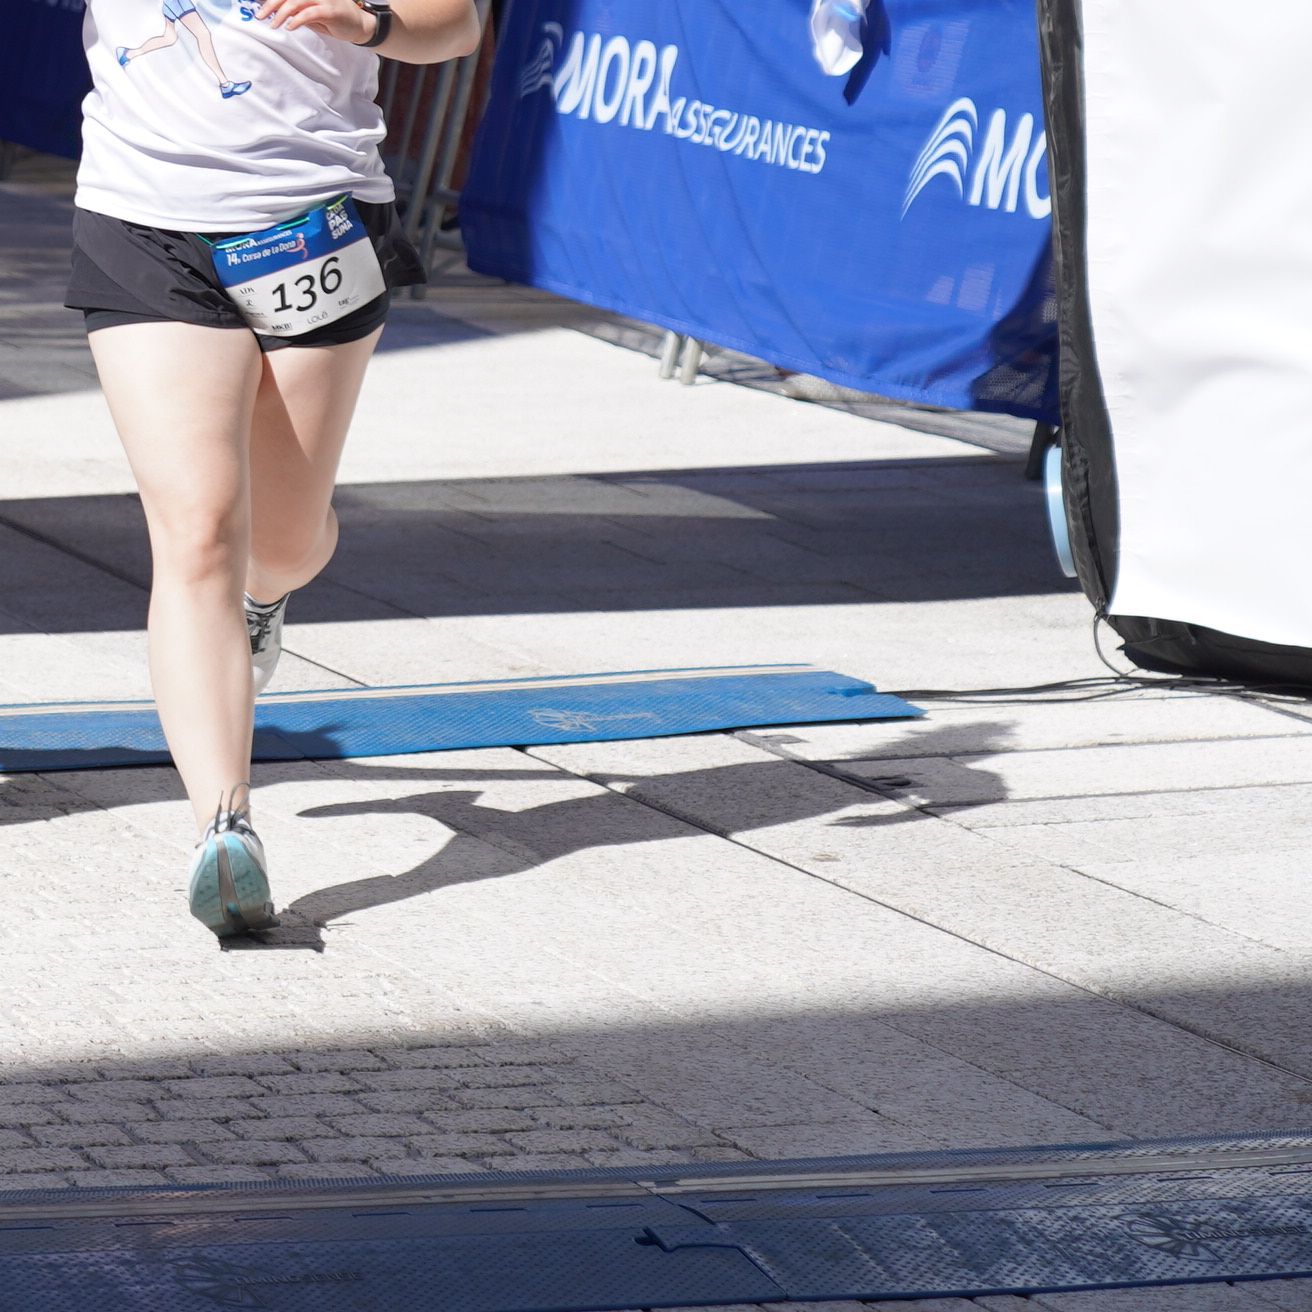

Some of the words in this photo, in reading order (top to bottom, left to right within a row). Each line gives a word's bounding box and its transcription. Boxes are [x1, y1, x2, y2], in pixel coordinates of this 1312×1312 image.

[554, 32, 678, 133] MORA
[675, 96, 831, 175] ASSEGURANCES
[328, 211, 349, 231] PAS
[242, 251, 262, 263] Cursa
[262, 248, 271, 258] de
[271, 246, 280, 255] la
[279, 240, 296, 252] Dona
[271, 256, 343, 313] 136
